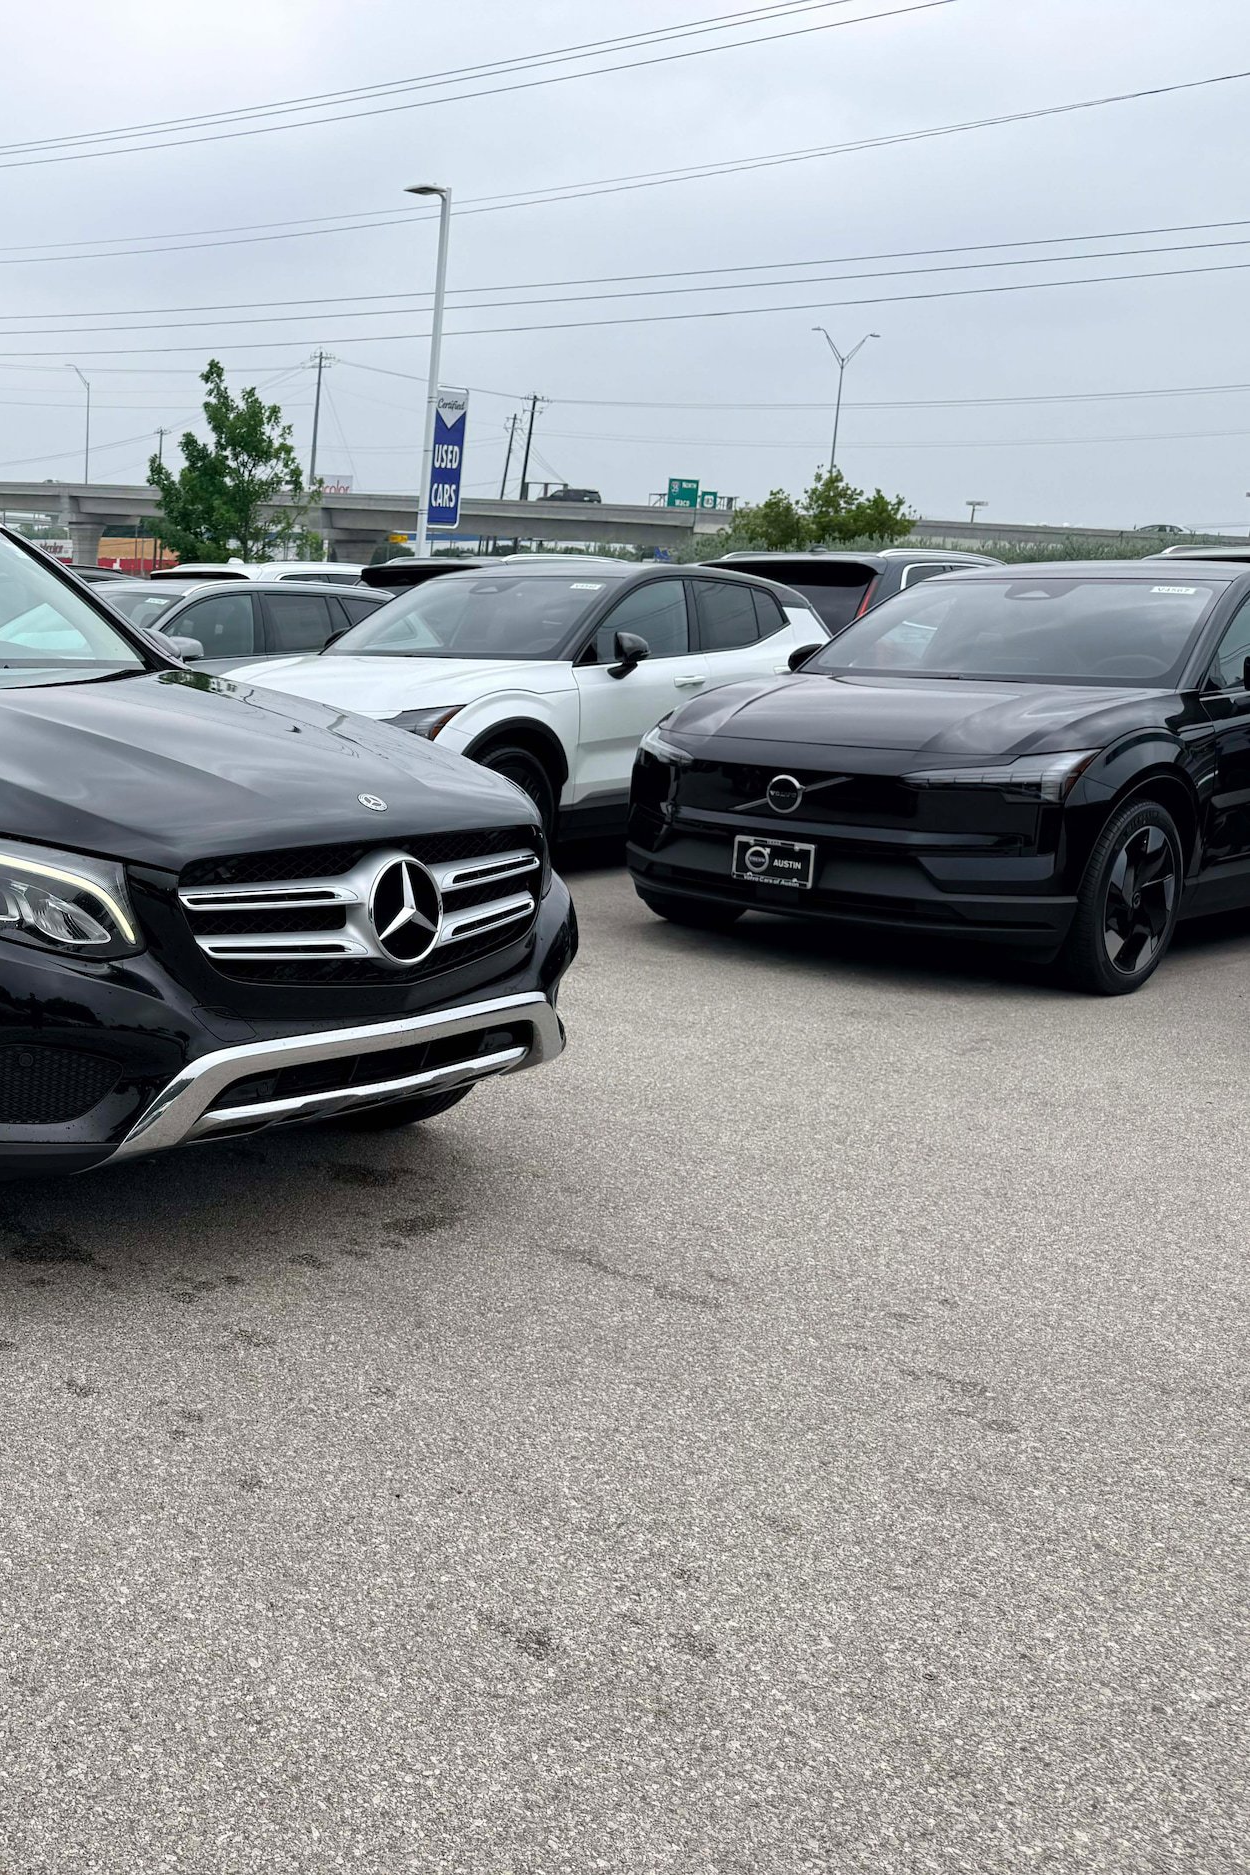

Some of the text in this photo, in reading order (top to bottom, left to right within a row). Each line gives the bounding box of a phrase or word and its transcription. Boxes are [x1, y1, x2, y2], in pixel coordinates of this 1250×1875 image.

[437, 398, 466, 412] Certified
[433, 444, 460, 469] USED
[431, 483, 457, 508] CARS
[770, 790, 797, 799] VOLVO
[773, 859, 802, 870] AUSTIN
